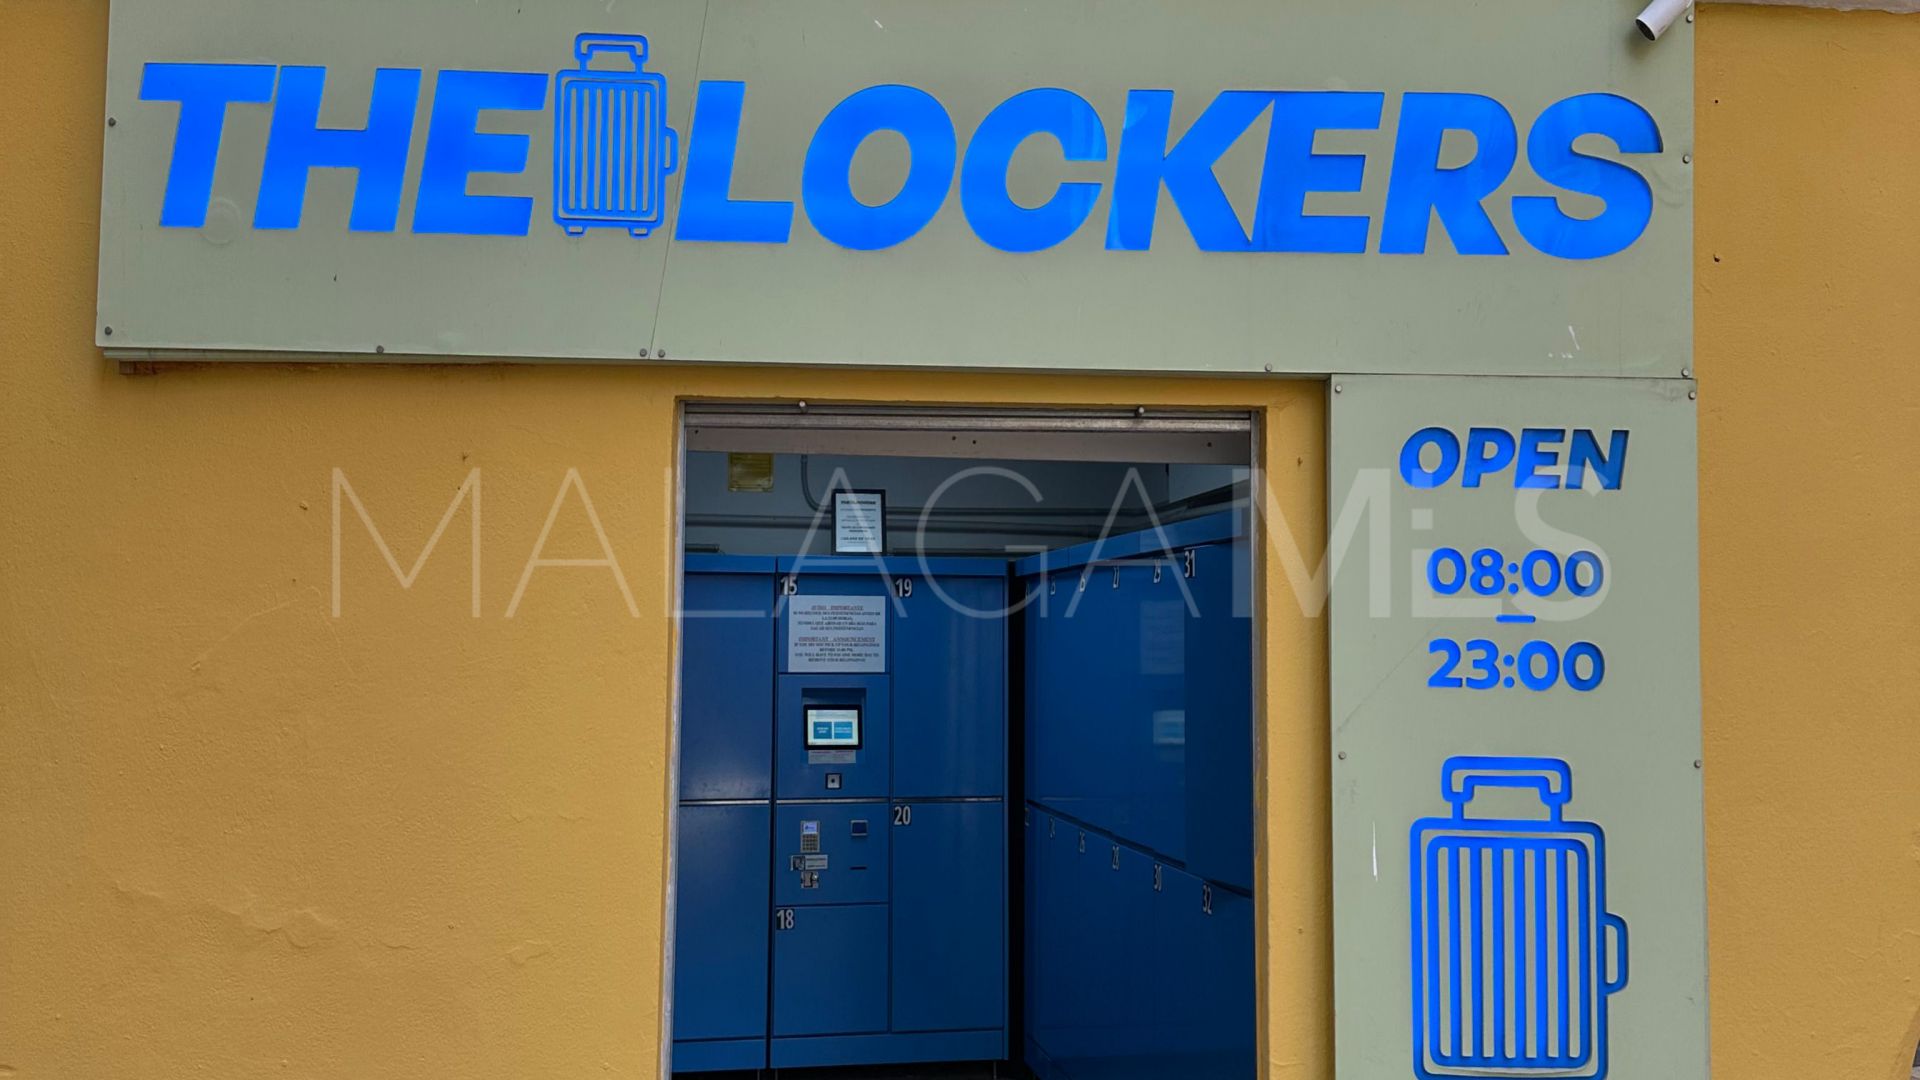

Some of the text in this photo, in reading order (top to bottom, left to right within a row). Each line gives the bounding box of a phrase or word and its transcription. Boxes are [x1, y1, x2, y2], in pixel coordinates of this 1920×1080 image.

[139, 63, 1664, 260] THE LOCKERS
[1399, 427, 1630, 490] OPEN
[1183, 549, 1196, 578] 31
[1426, 547, 1604, 597] 08:00
[780, 576, 798, 595] 15
[895, 578, 913, 597] 19
[1427, 638, 1606, 692] 23:00
[894, 806, 911, 825] 20
[1202, 884, 1213, 915] 32
[777, 909, 795, 930] 18
